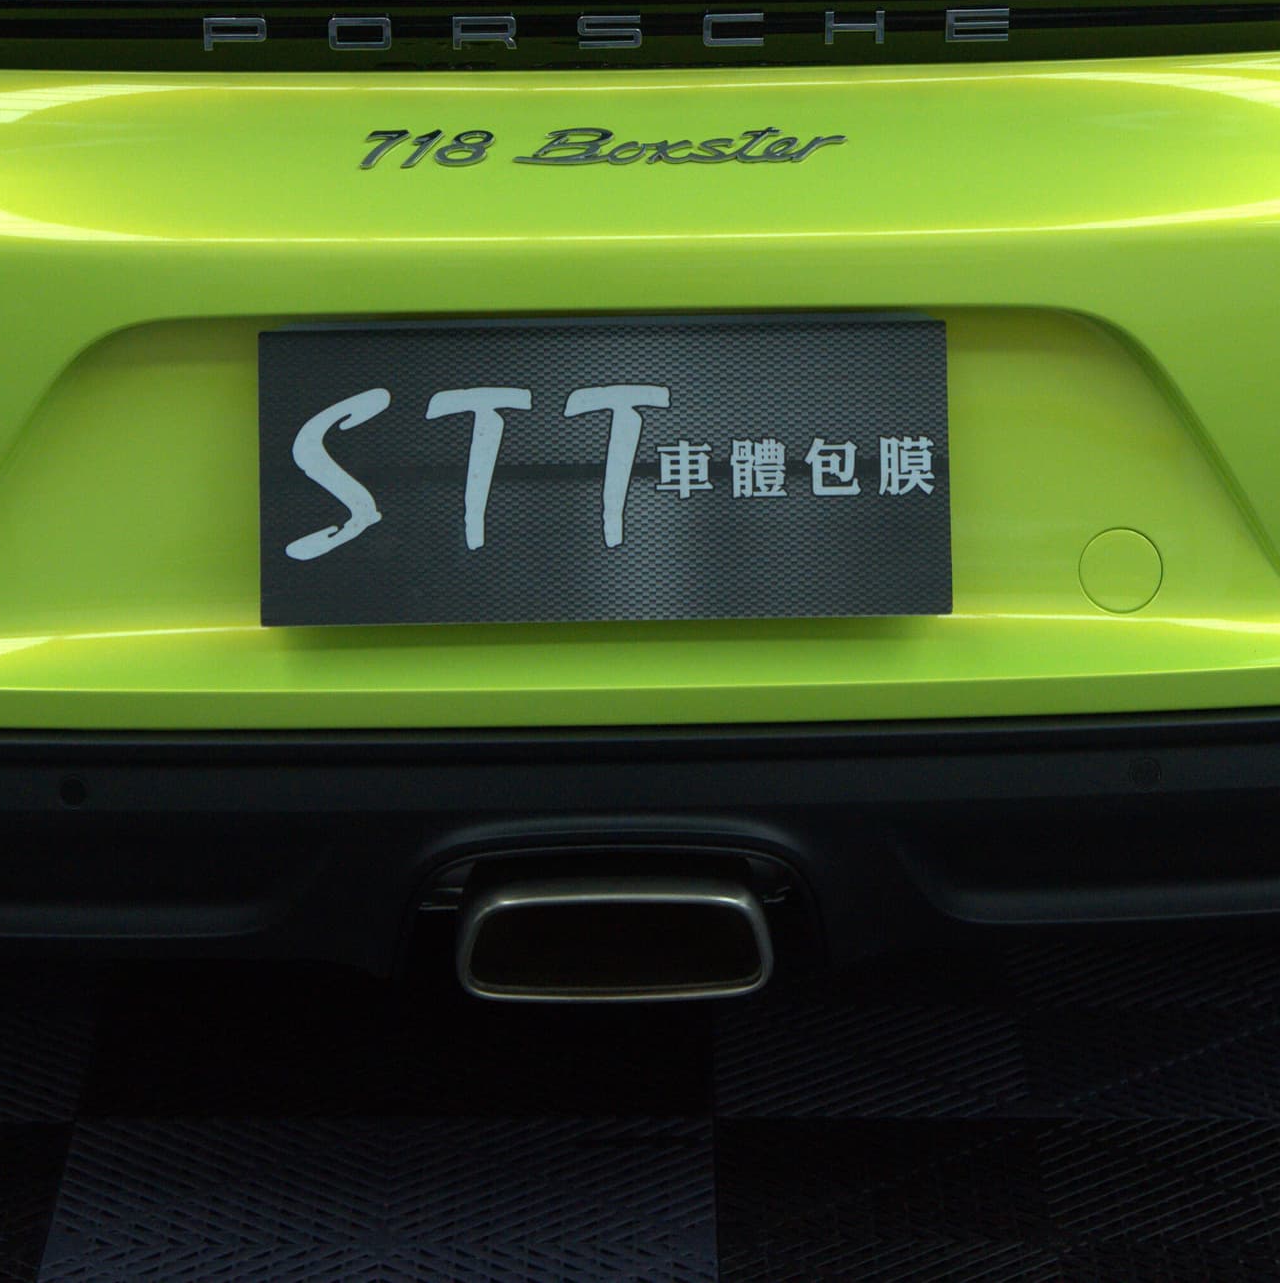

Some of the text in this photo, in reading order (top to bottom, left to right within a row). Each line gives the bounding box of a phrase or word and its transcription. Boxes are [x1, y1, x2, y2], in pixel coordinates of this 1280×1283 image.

[202, 8, 1010, 52] PORSCHE
[359, 126, 847, 169] 718 Boxster
[284, 384, 936, 561] STT 車體包膜
